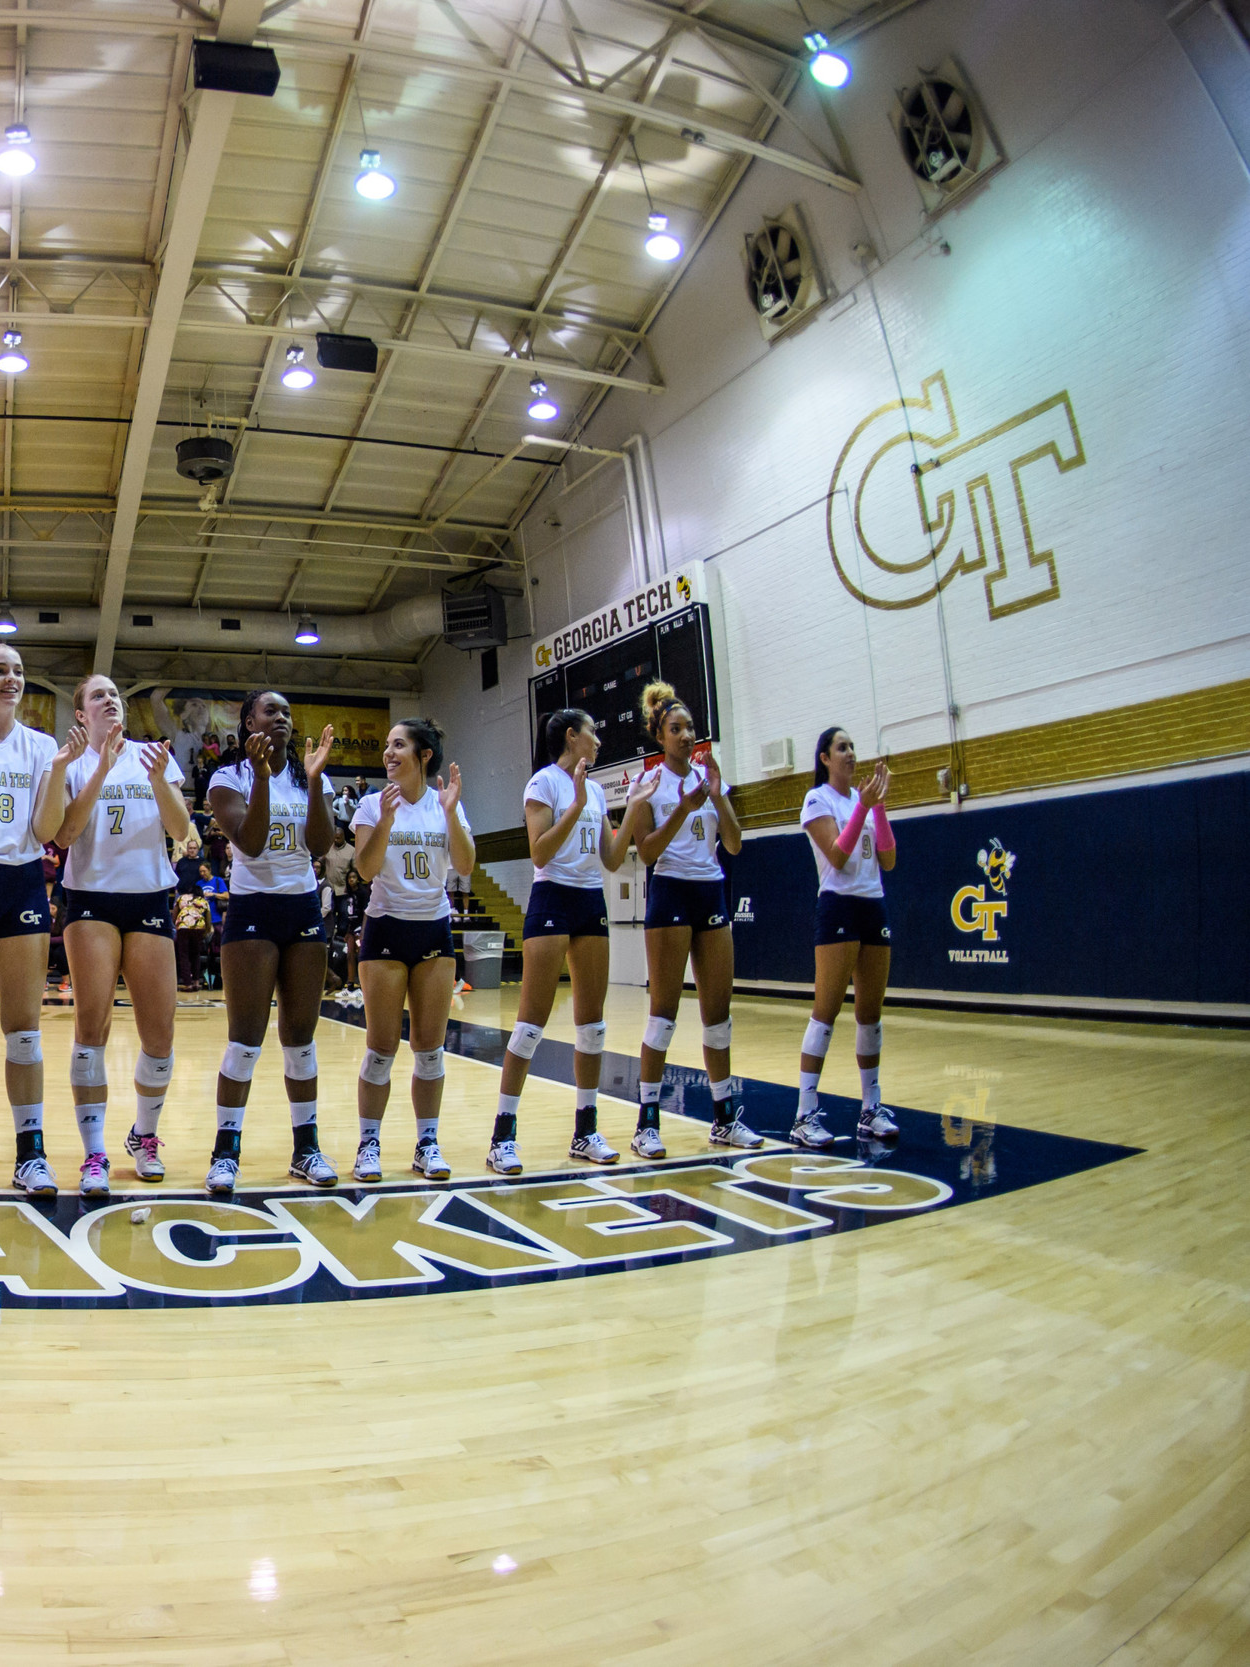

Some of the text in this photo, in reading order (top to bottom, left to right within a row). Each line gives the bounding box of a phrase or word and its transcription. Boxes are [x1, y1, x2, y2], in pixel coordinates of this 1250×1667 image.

[826, 369, 1087, 622] GT
[535, 580, 673, 667] GT GEORGIA TECH
[603, 680, 618, 692] GAME
[9, 772, 31, 789] TEC
[614, 785, 630, 796] POWE
[107, 806, 125, 835] 7
[690, 816, 705, 841] 4
[269, 823, 297, 851] 21
[579, 827, 596, 854] 11
[862, 834, 873, 860] 9
[402, 852, 430, 879] 10
[19, 910, 42, 925] GT
[951, 884, 1008, 941] GT
[948, 950, 1009, 963] VOLLEYBALL
